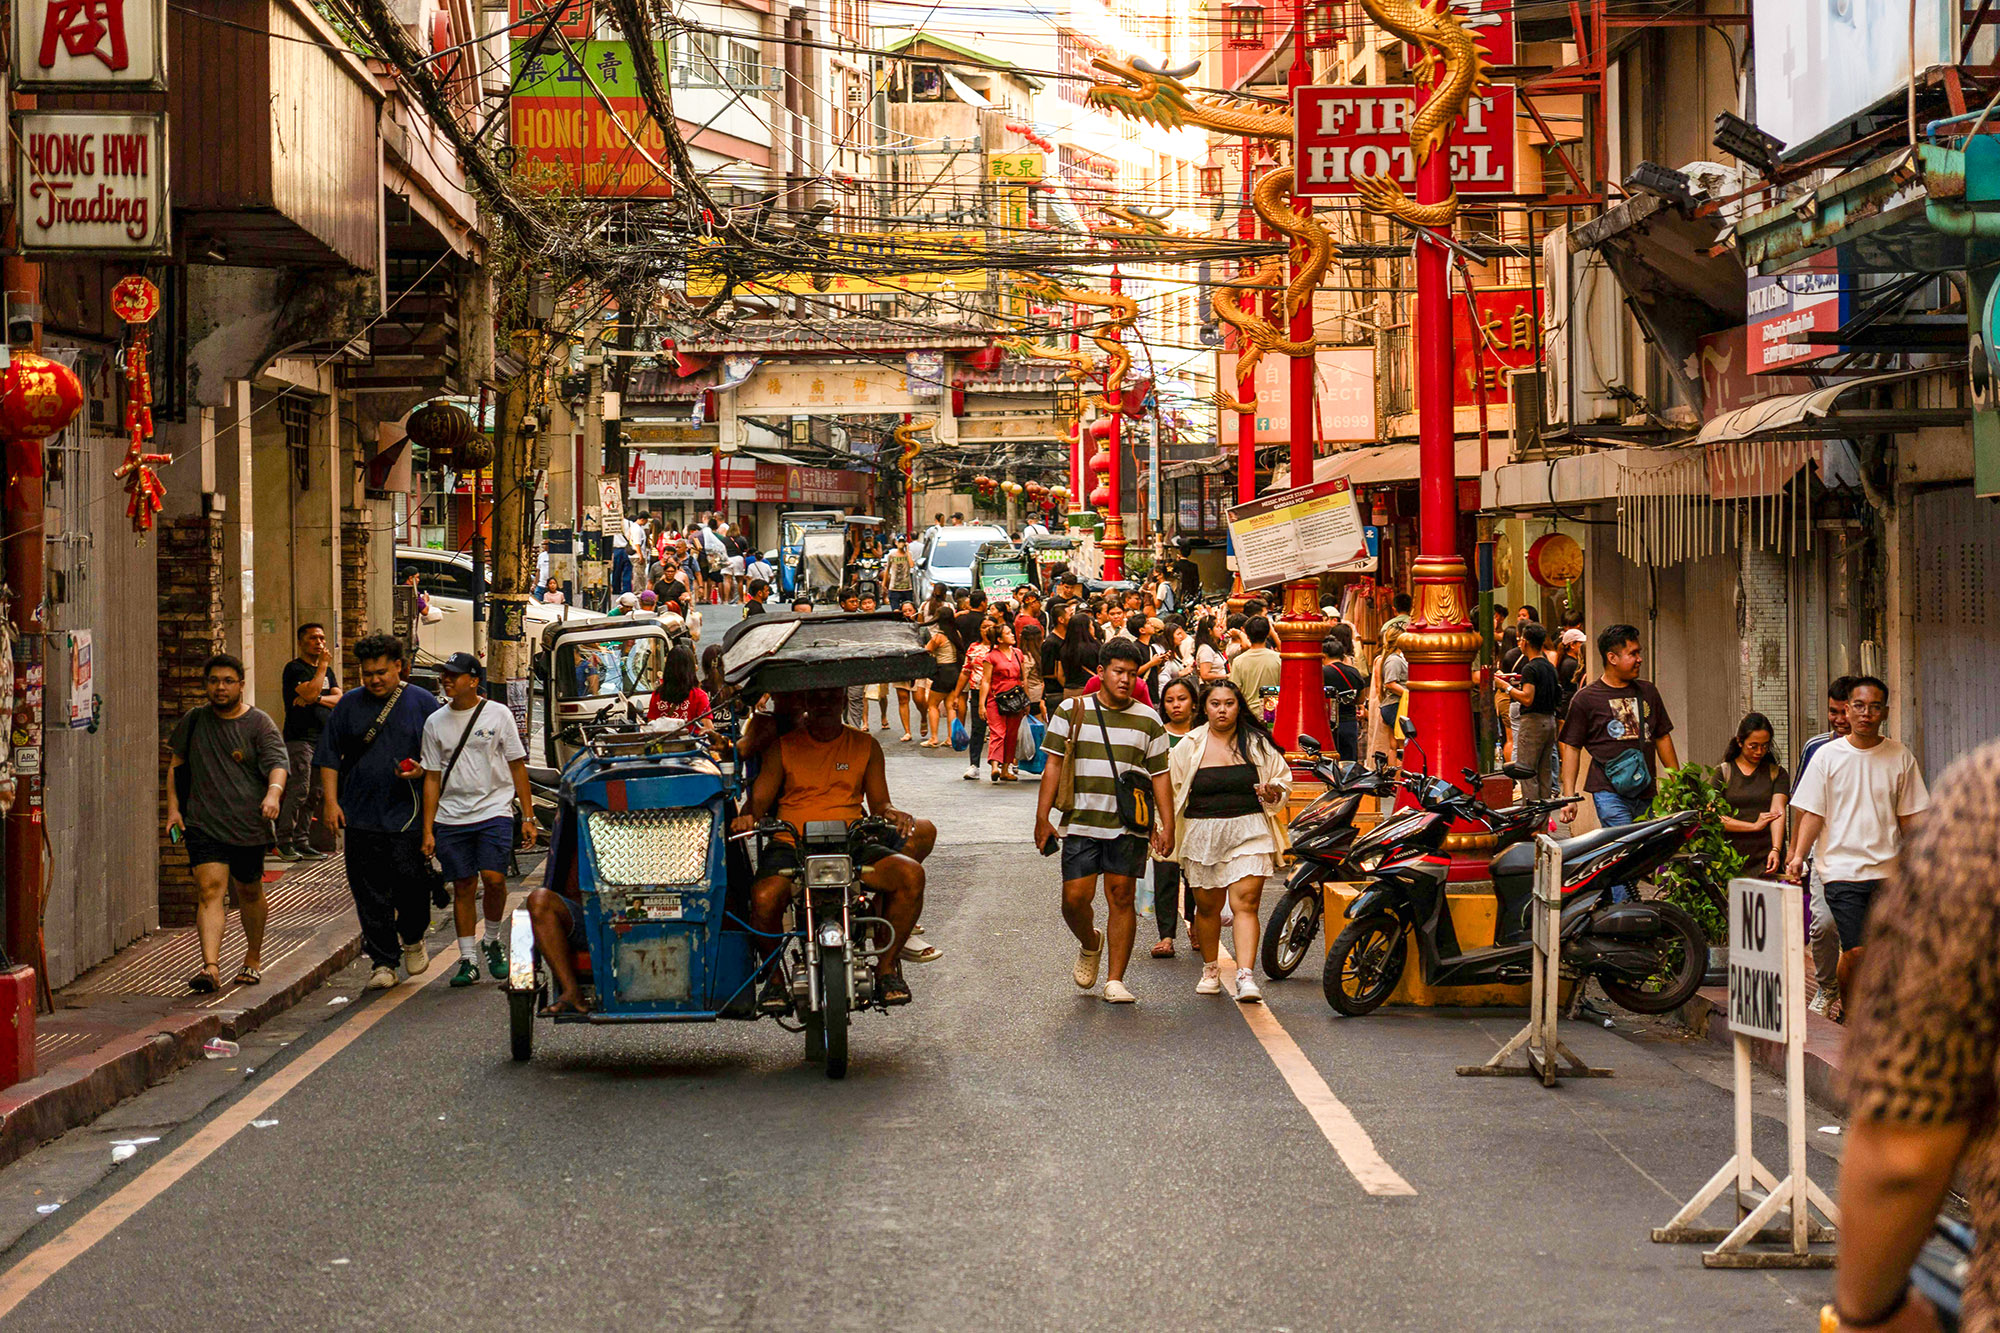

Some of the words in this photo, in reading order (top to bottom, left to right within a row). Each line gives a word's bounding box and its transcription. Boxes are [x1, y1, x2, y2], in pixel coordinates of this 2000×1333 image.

[517, 108, 589, 150] HONG
[1316, 97, 1494, 136] FIRT
[30, 133, 95, 176] HONG
[103, 134, 148, 176] HWI
[30, 182, 149, 241] Trading
[646, 468, 679, 489] mercury
[681, 465, 699, 490] drug
[21, 753, 36, 761] ARK
[1309, 836, 1330, 847] HONDA
[1394, 848, 1419, 859] HONDA
[1564, 848, 1629, 887] CLICK
[1742, 890, 1767, 952] NO
[1730, 963, 1782, 1033] PARKING
